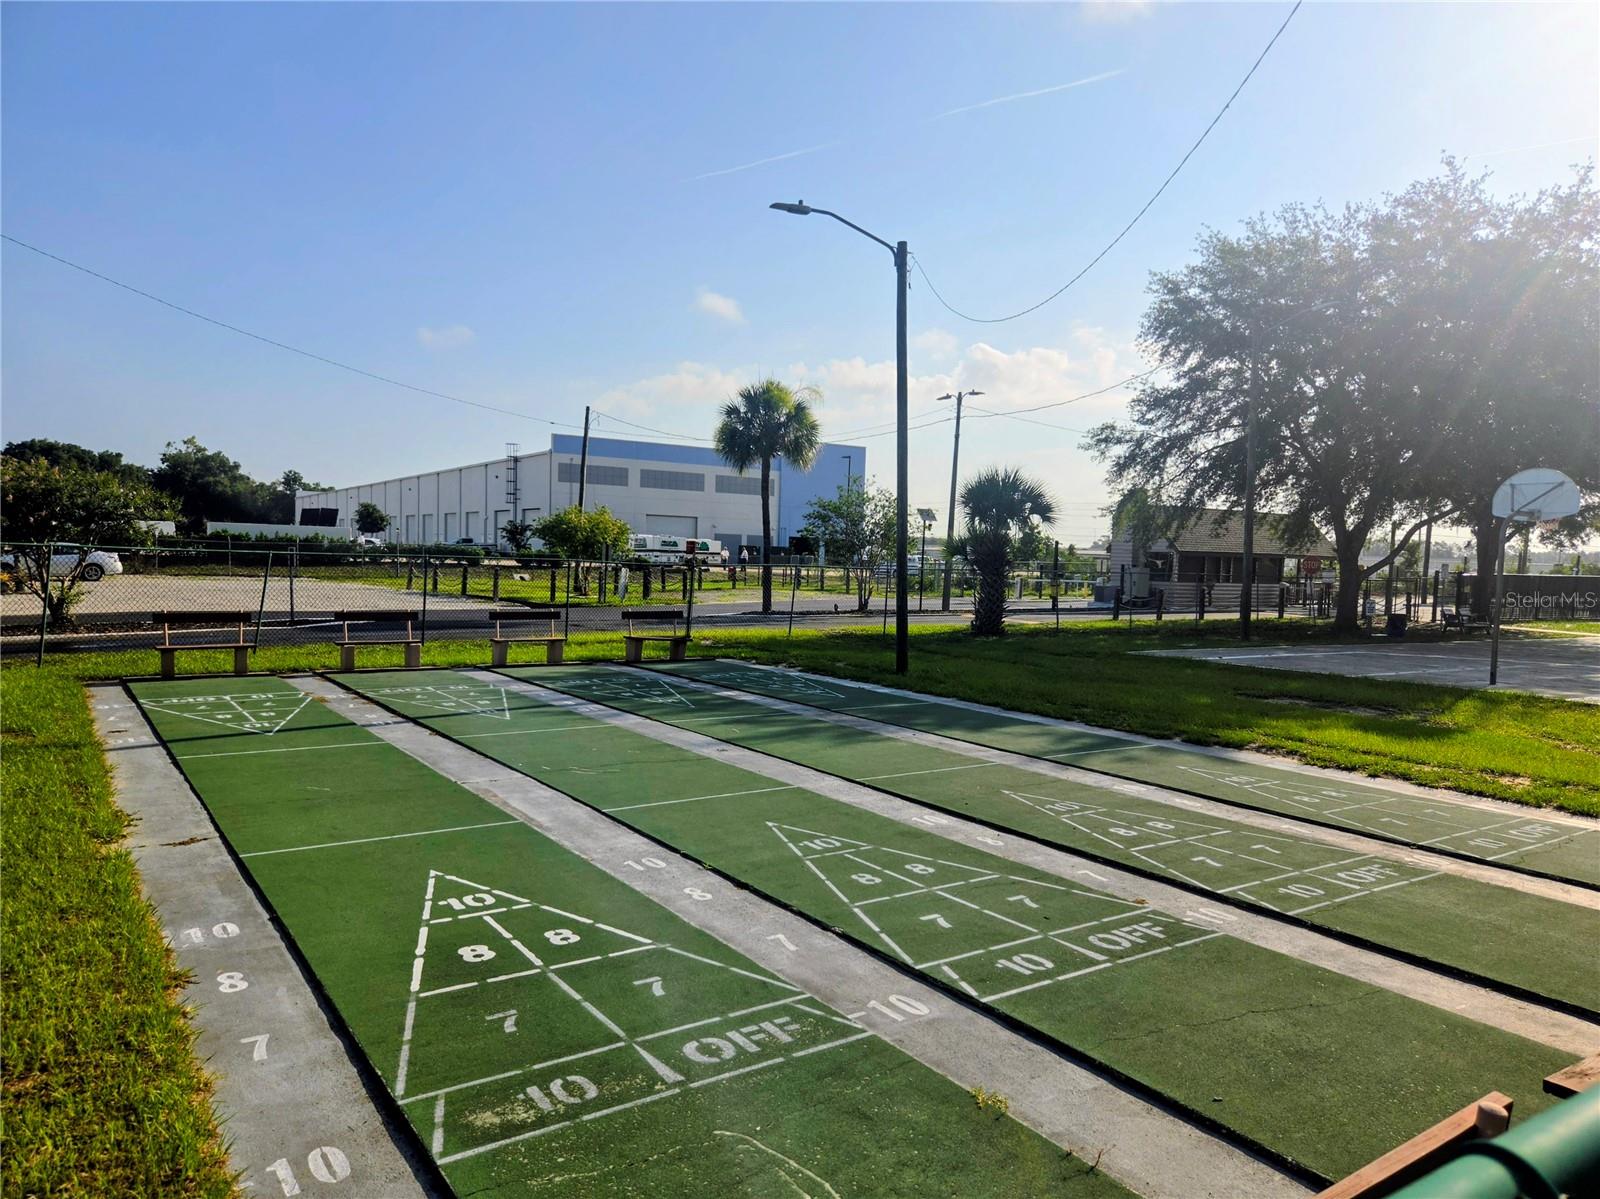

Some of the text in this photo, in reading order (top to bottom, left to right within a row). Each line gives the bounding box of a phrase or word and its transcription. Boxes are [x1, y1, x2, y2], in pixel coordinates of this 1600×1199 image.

[1303, 560, 1319, 569] STOP
[1044, 801, 1081, 812] 10
[911, 815, 949, 826] 10
[1146, 821, 1176, 830] 8
[1108, 827, 1138, 837] 8
[799, 838, 842, 850] 10
[976, 836, 1004, 846] 8
[1466, 838, 1508, 850] 10
[1251, 844, 1281, 854] 7
[623, 857, 667, 872] 10
[904, 863, 936, 875] 8
[1191, 856, 1224, 868] 7
[851, 873, 882, 885] 8
[1077, 869, 1110, 882] 7
[1278, 864, 1400, 899] 10 OFF
[683, 887, 713, 901] 8
[1006, 894, 1040, 909] 7
[438, 893, 496, 911] 10
[919, 913, 953, 929] 7
[183, 921, 240, 943] 10
[543, 928, 581, 946] 8
[766, 934, 799, 951] 7
[995, 921, 1167, 976] 10 OFF
[457, 944, 497, 963] 8
[216, 971, 249, 993] 8
[632, 975, 666, 997] 7
[485, 1009, 519, 1033] 7
[240, 1033, 270, 1061] 7
[516, 1016, 802, 1113] 10 OFF
